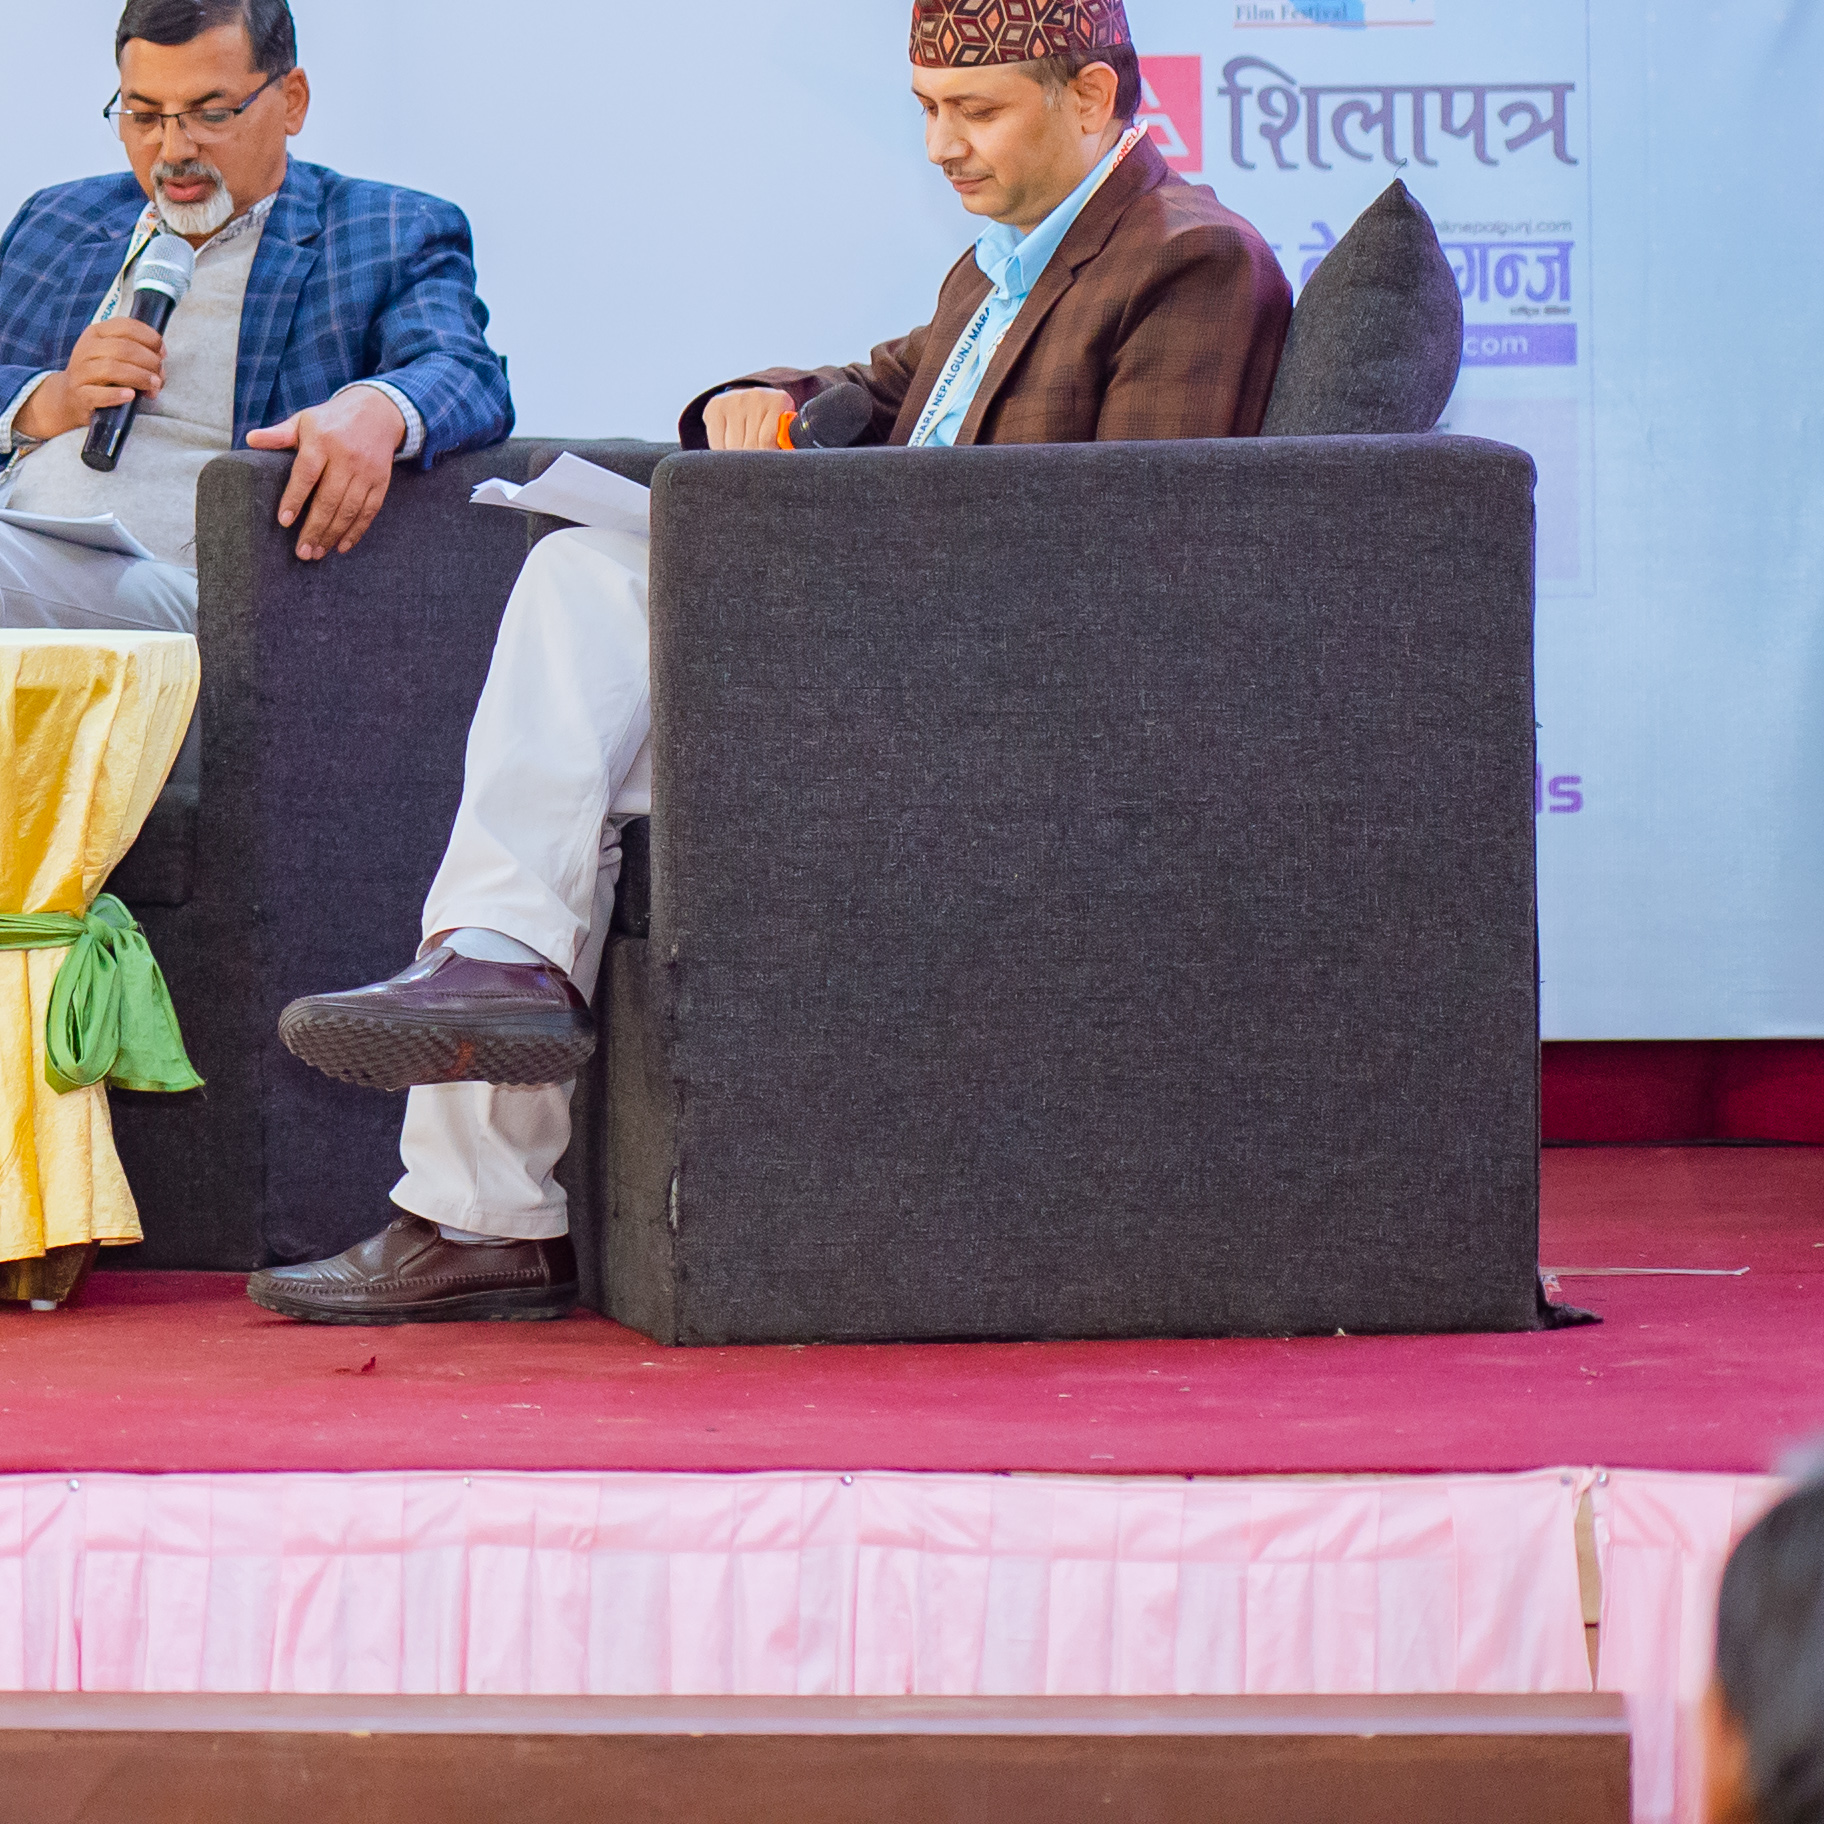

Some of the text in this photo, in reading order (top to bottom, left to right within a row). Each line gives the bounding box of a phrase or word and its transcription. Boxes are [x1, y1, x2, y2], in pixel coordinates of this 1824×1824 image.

[1236, 2, 1347, 21] Film Festival
[1218, 55, 1579, 171] शिलापत्र
[934, 339, 973, 409] NEPALGUNJ
